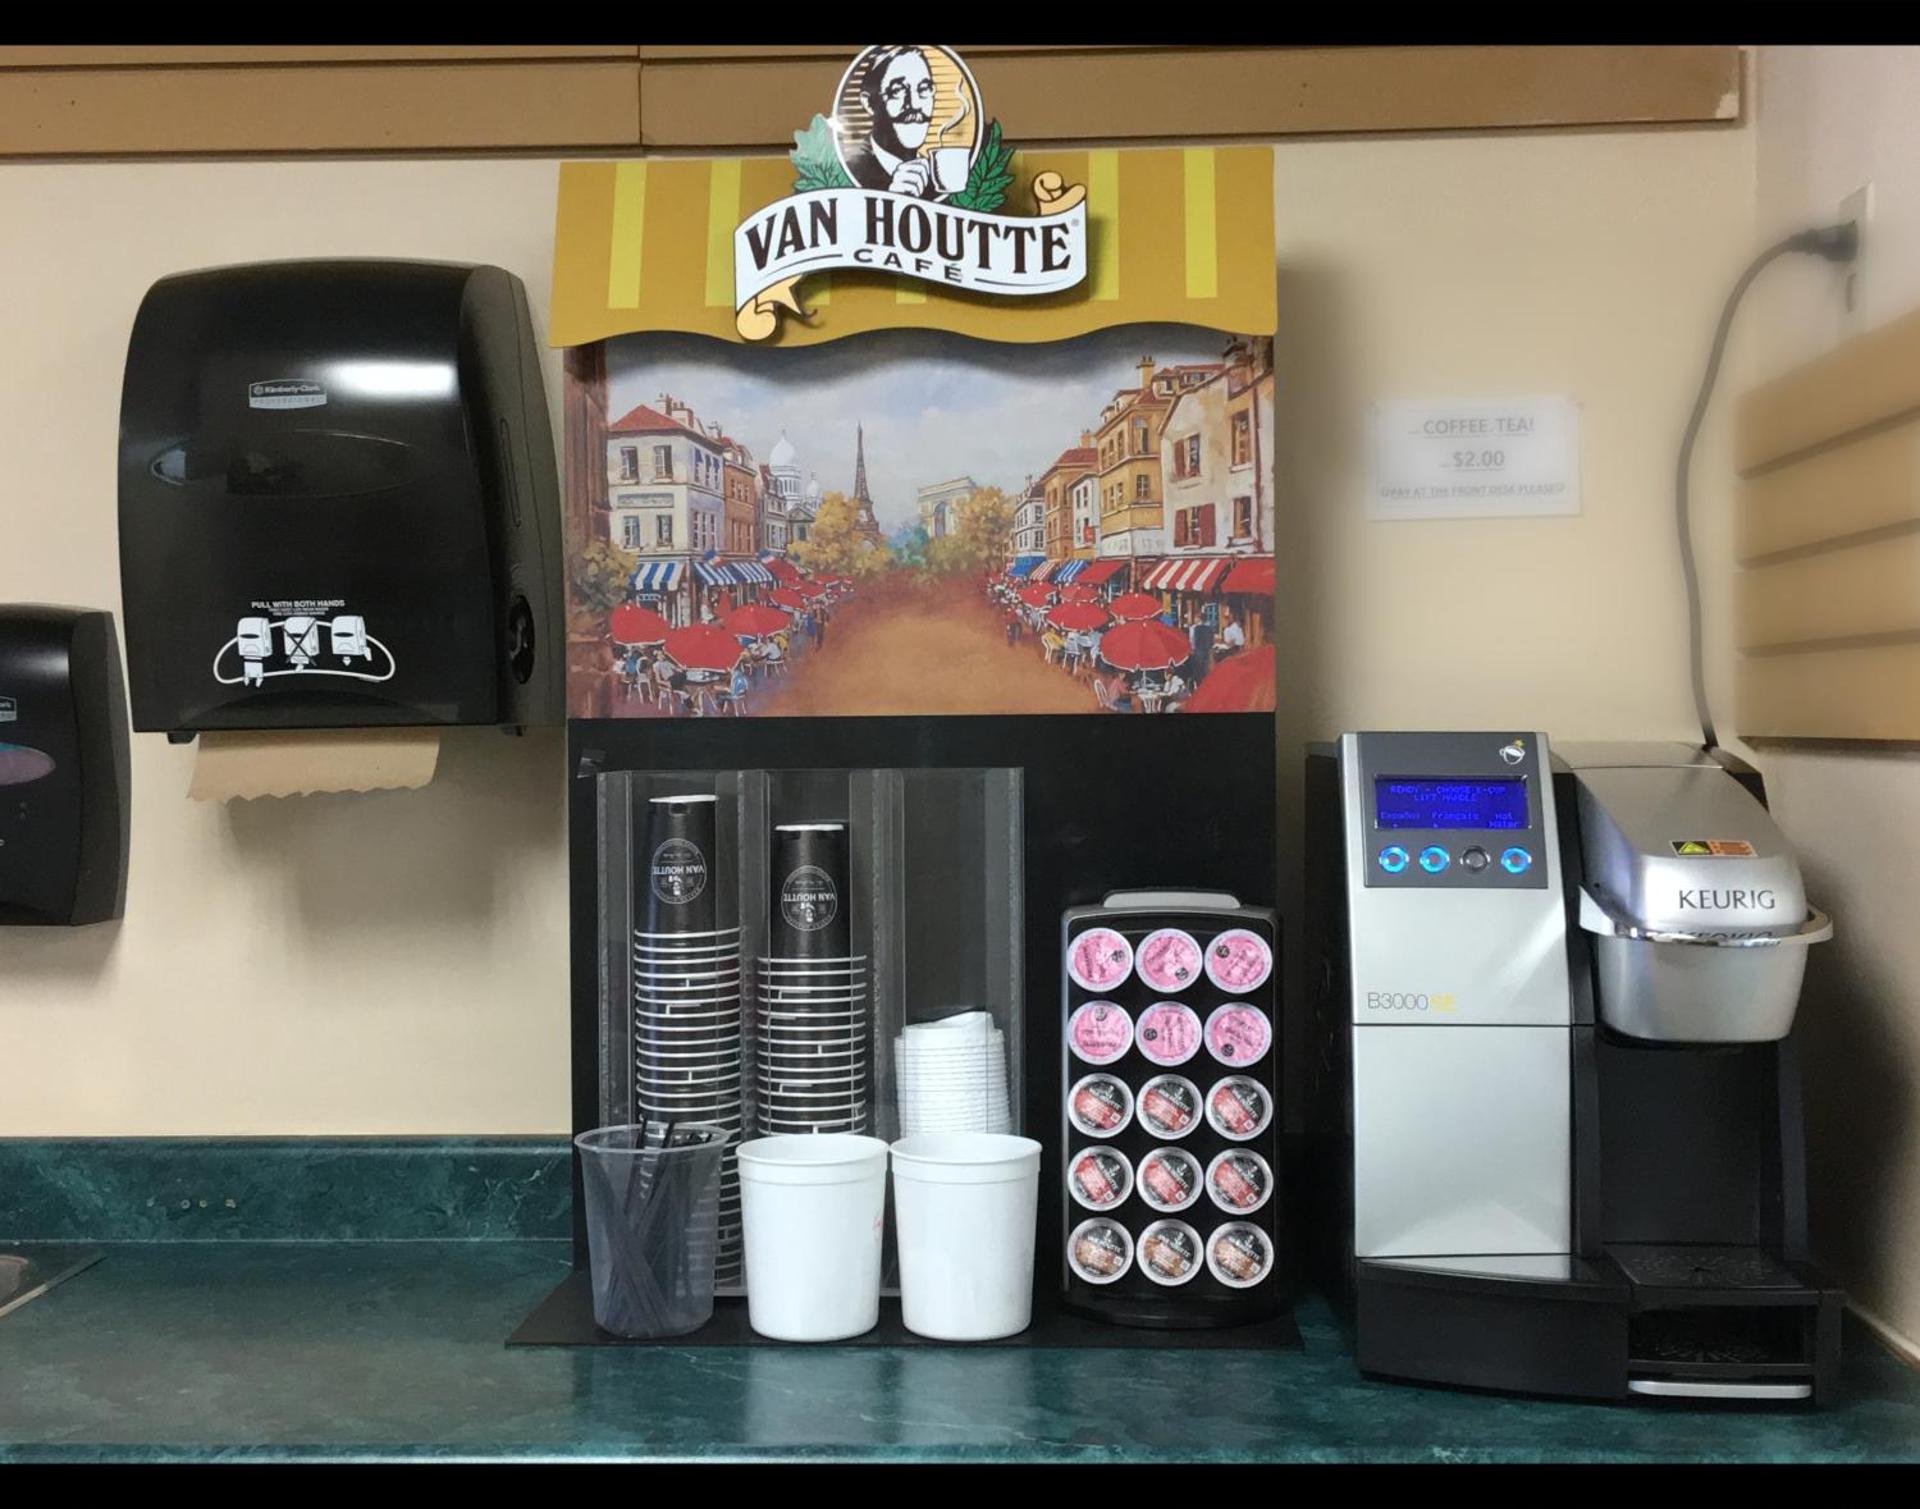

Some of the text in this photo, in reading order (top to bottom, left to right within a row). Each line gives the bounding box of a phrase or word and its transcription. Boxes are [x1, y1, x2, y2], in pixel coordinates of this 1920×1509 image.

[744, 196, 1072, 275] VAN HOUTTE
[853, 248, 963, 283] CAFÉ
[1423, 418, 1488, 435] COFFEE
[1453, 450, 1505, 468] $2.00
[1452, 485, 1487, 497] FRONT
[272, 600, 292, 608] WITH
[294, 600, 316, 608] BOTH
[317, 599, 345, 607] HANDS
[653, 865, 705, 875] VAN HOUTTE
[783, 892, 836, 902] VAN HOUTTE
[1679, 889, 1776, 909] KEURIG
